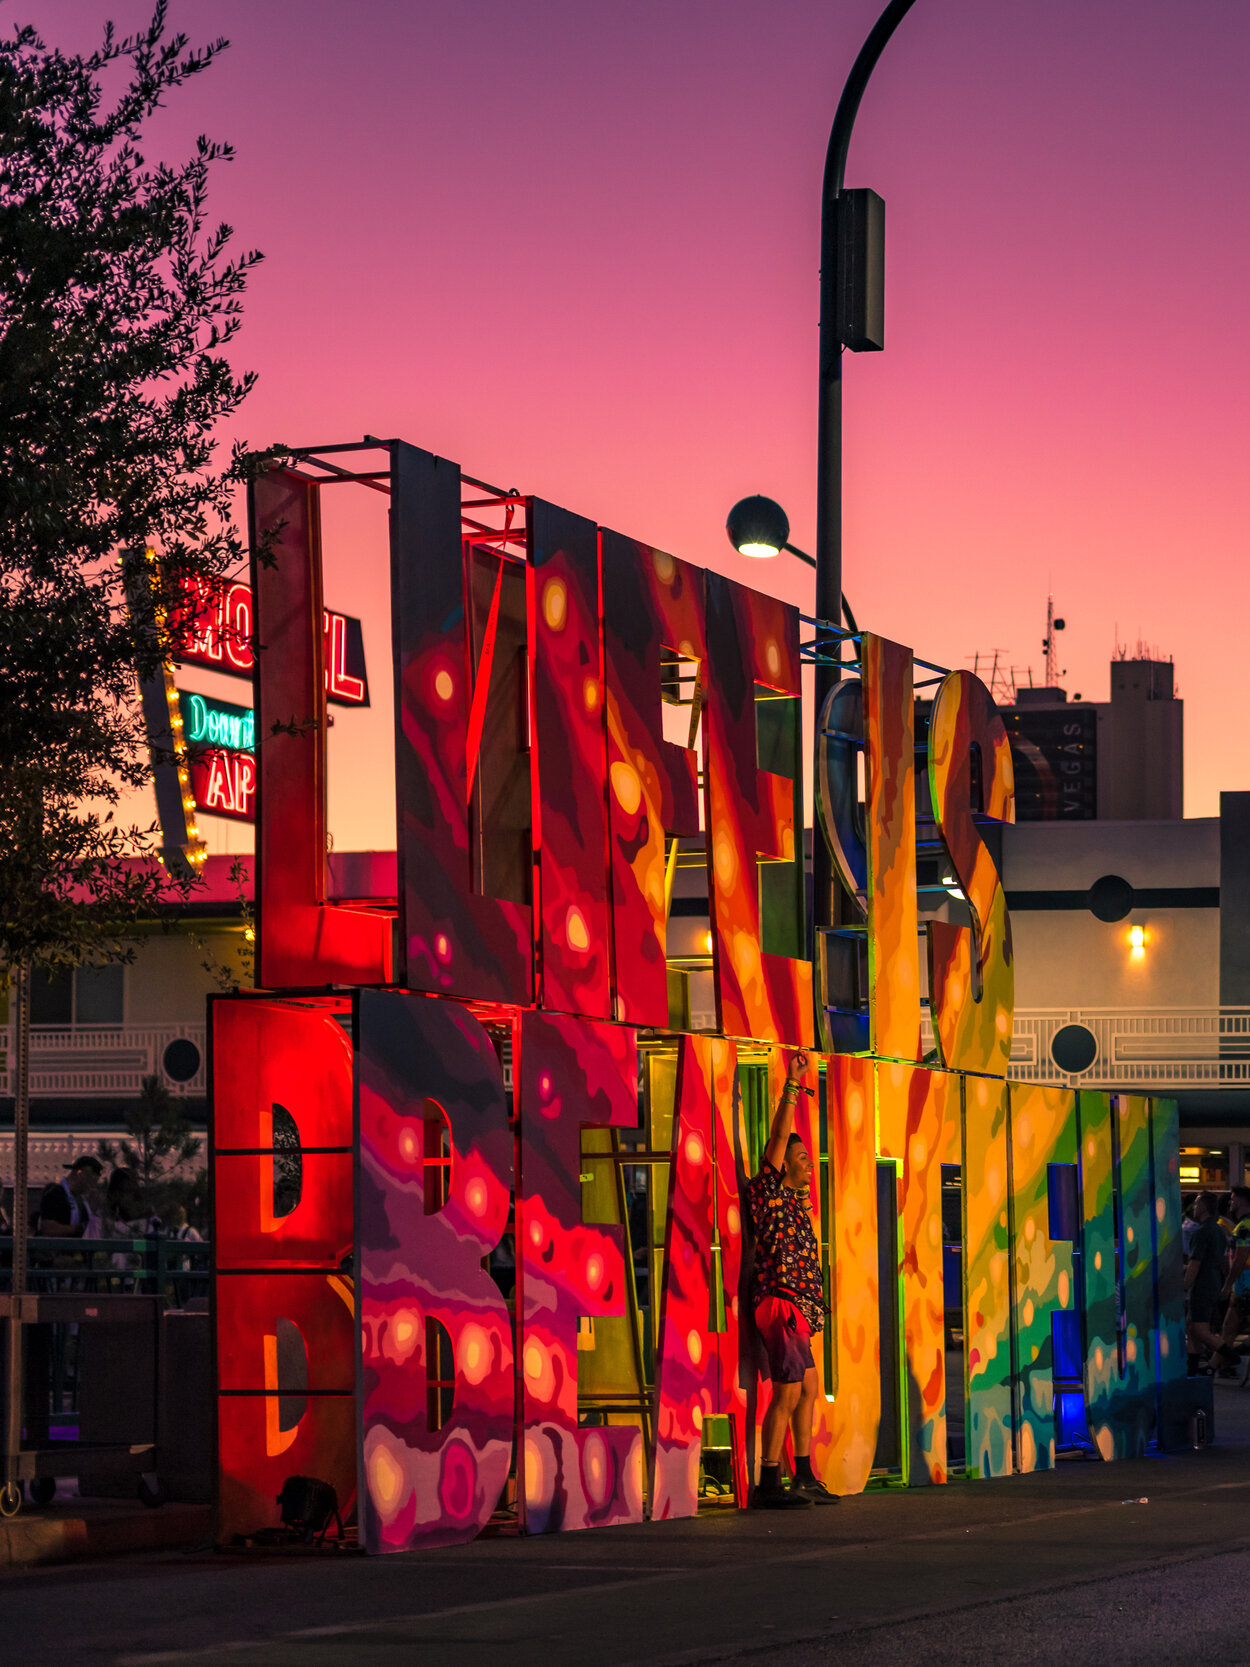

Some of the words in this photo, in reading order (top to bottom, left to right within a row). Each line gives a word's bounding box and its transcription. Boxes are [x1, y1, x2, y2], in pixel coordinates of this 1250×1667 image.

[184, 570, 364, 701] MOL
[391, 437, 818, 1047] LIFE
[863, 632, 1016, 1080] IS
[1063, 722, 1082, 812] VEGAS
[356, 988, 1213, 1556] BEAUTIFUL
